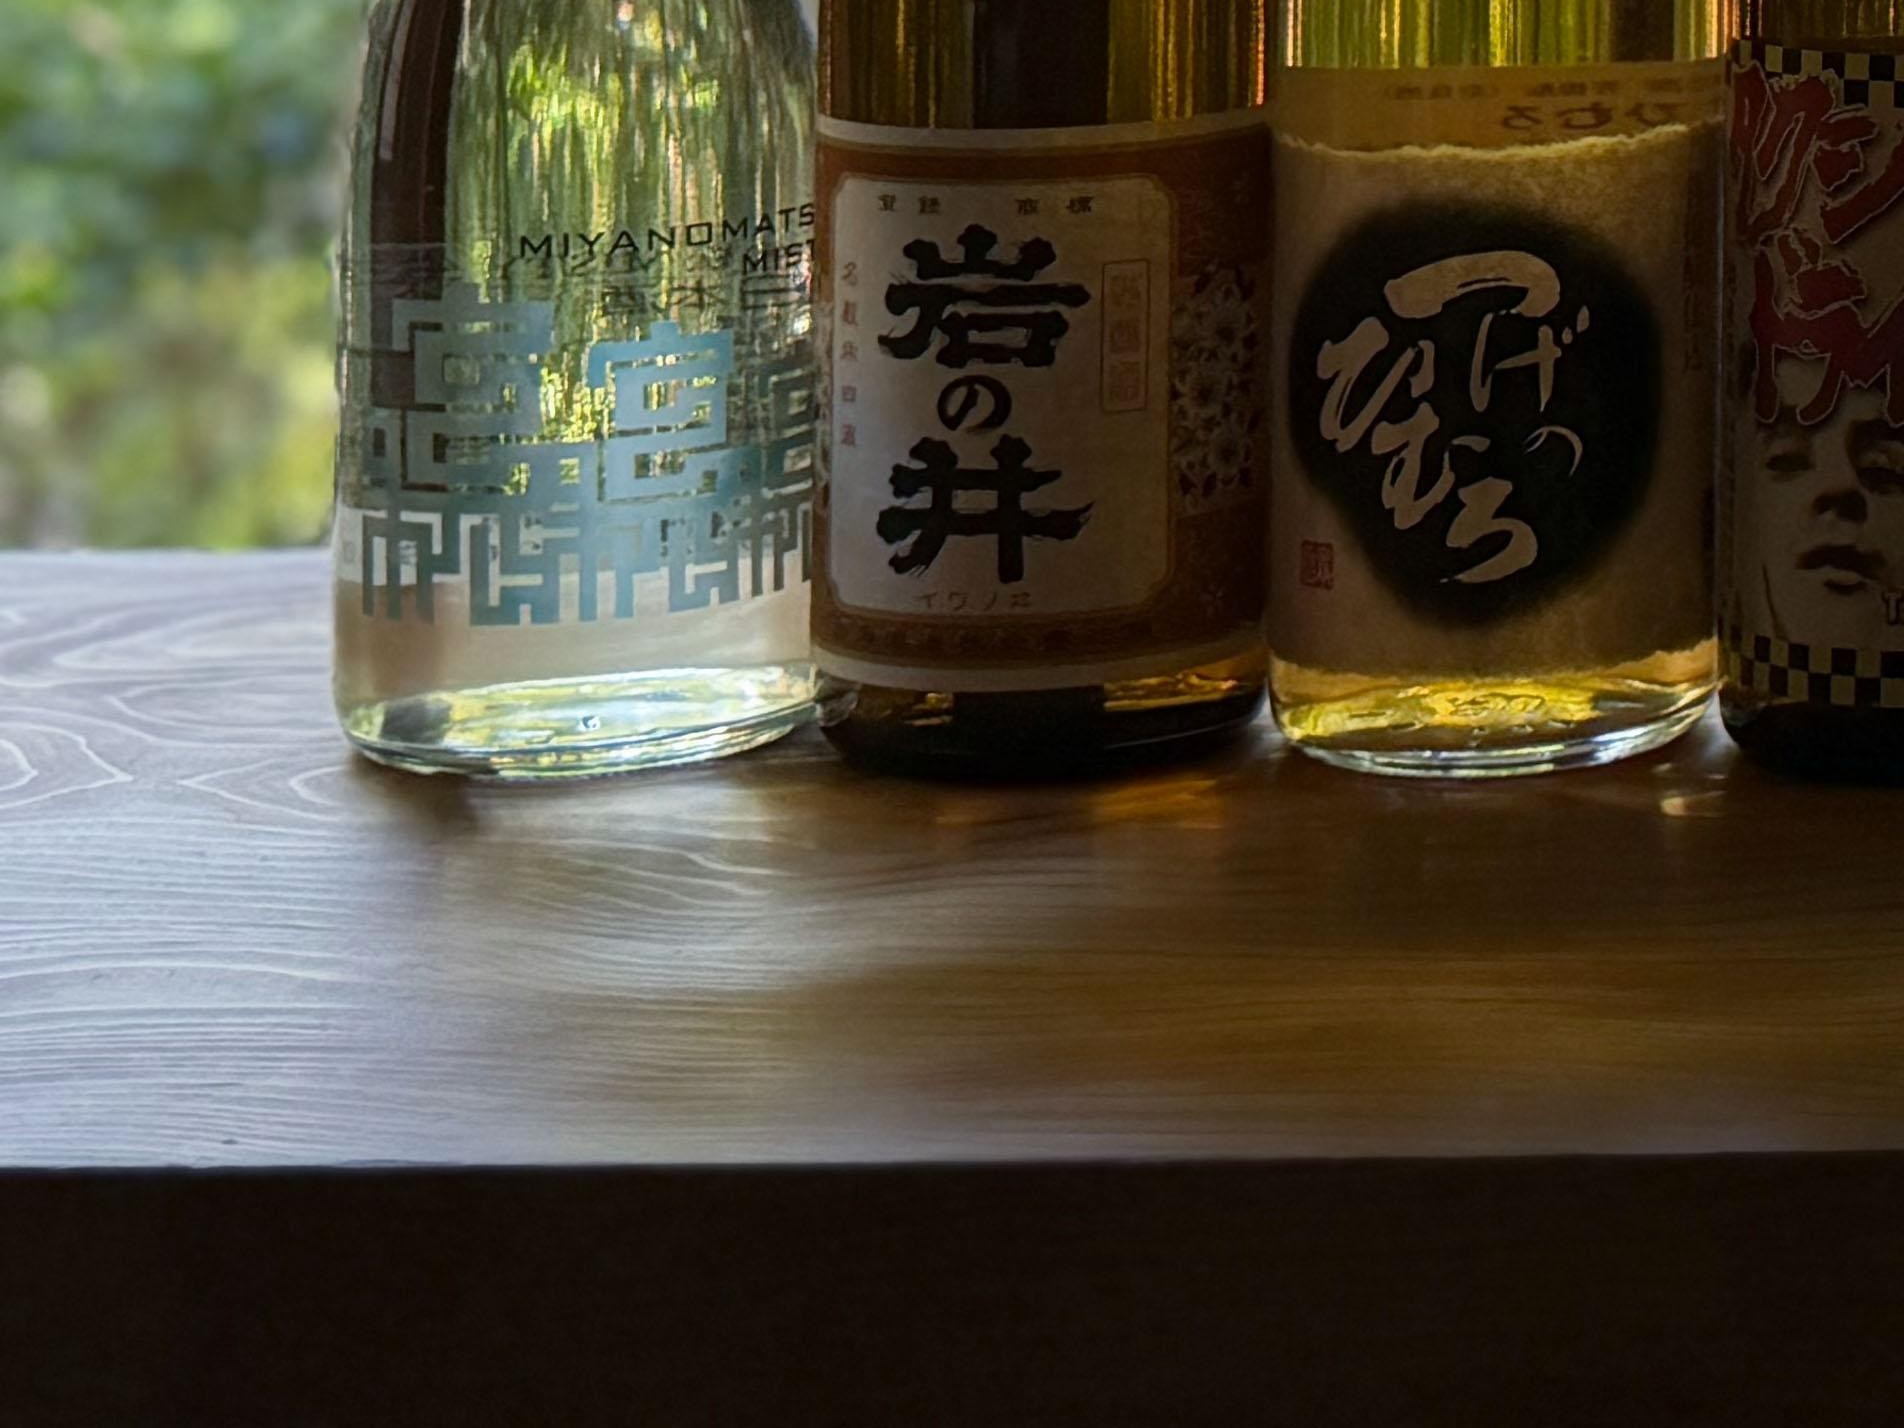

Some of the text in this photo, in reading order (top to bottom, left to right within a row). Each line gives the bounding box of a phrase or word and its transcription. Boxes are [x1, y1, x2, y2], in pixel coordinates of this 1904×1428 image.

[520, 202, 815, 258] MIYANOMATS
[878, 223, 1095, 584] 岩の井
